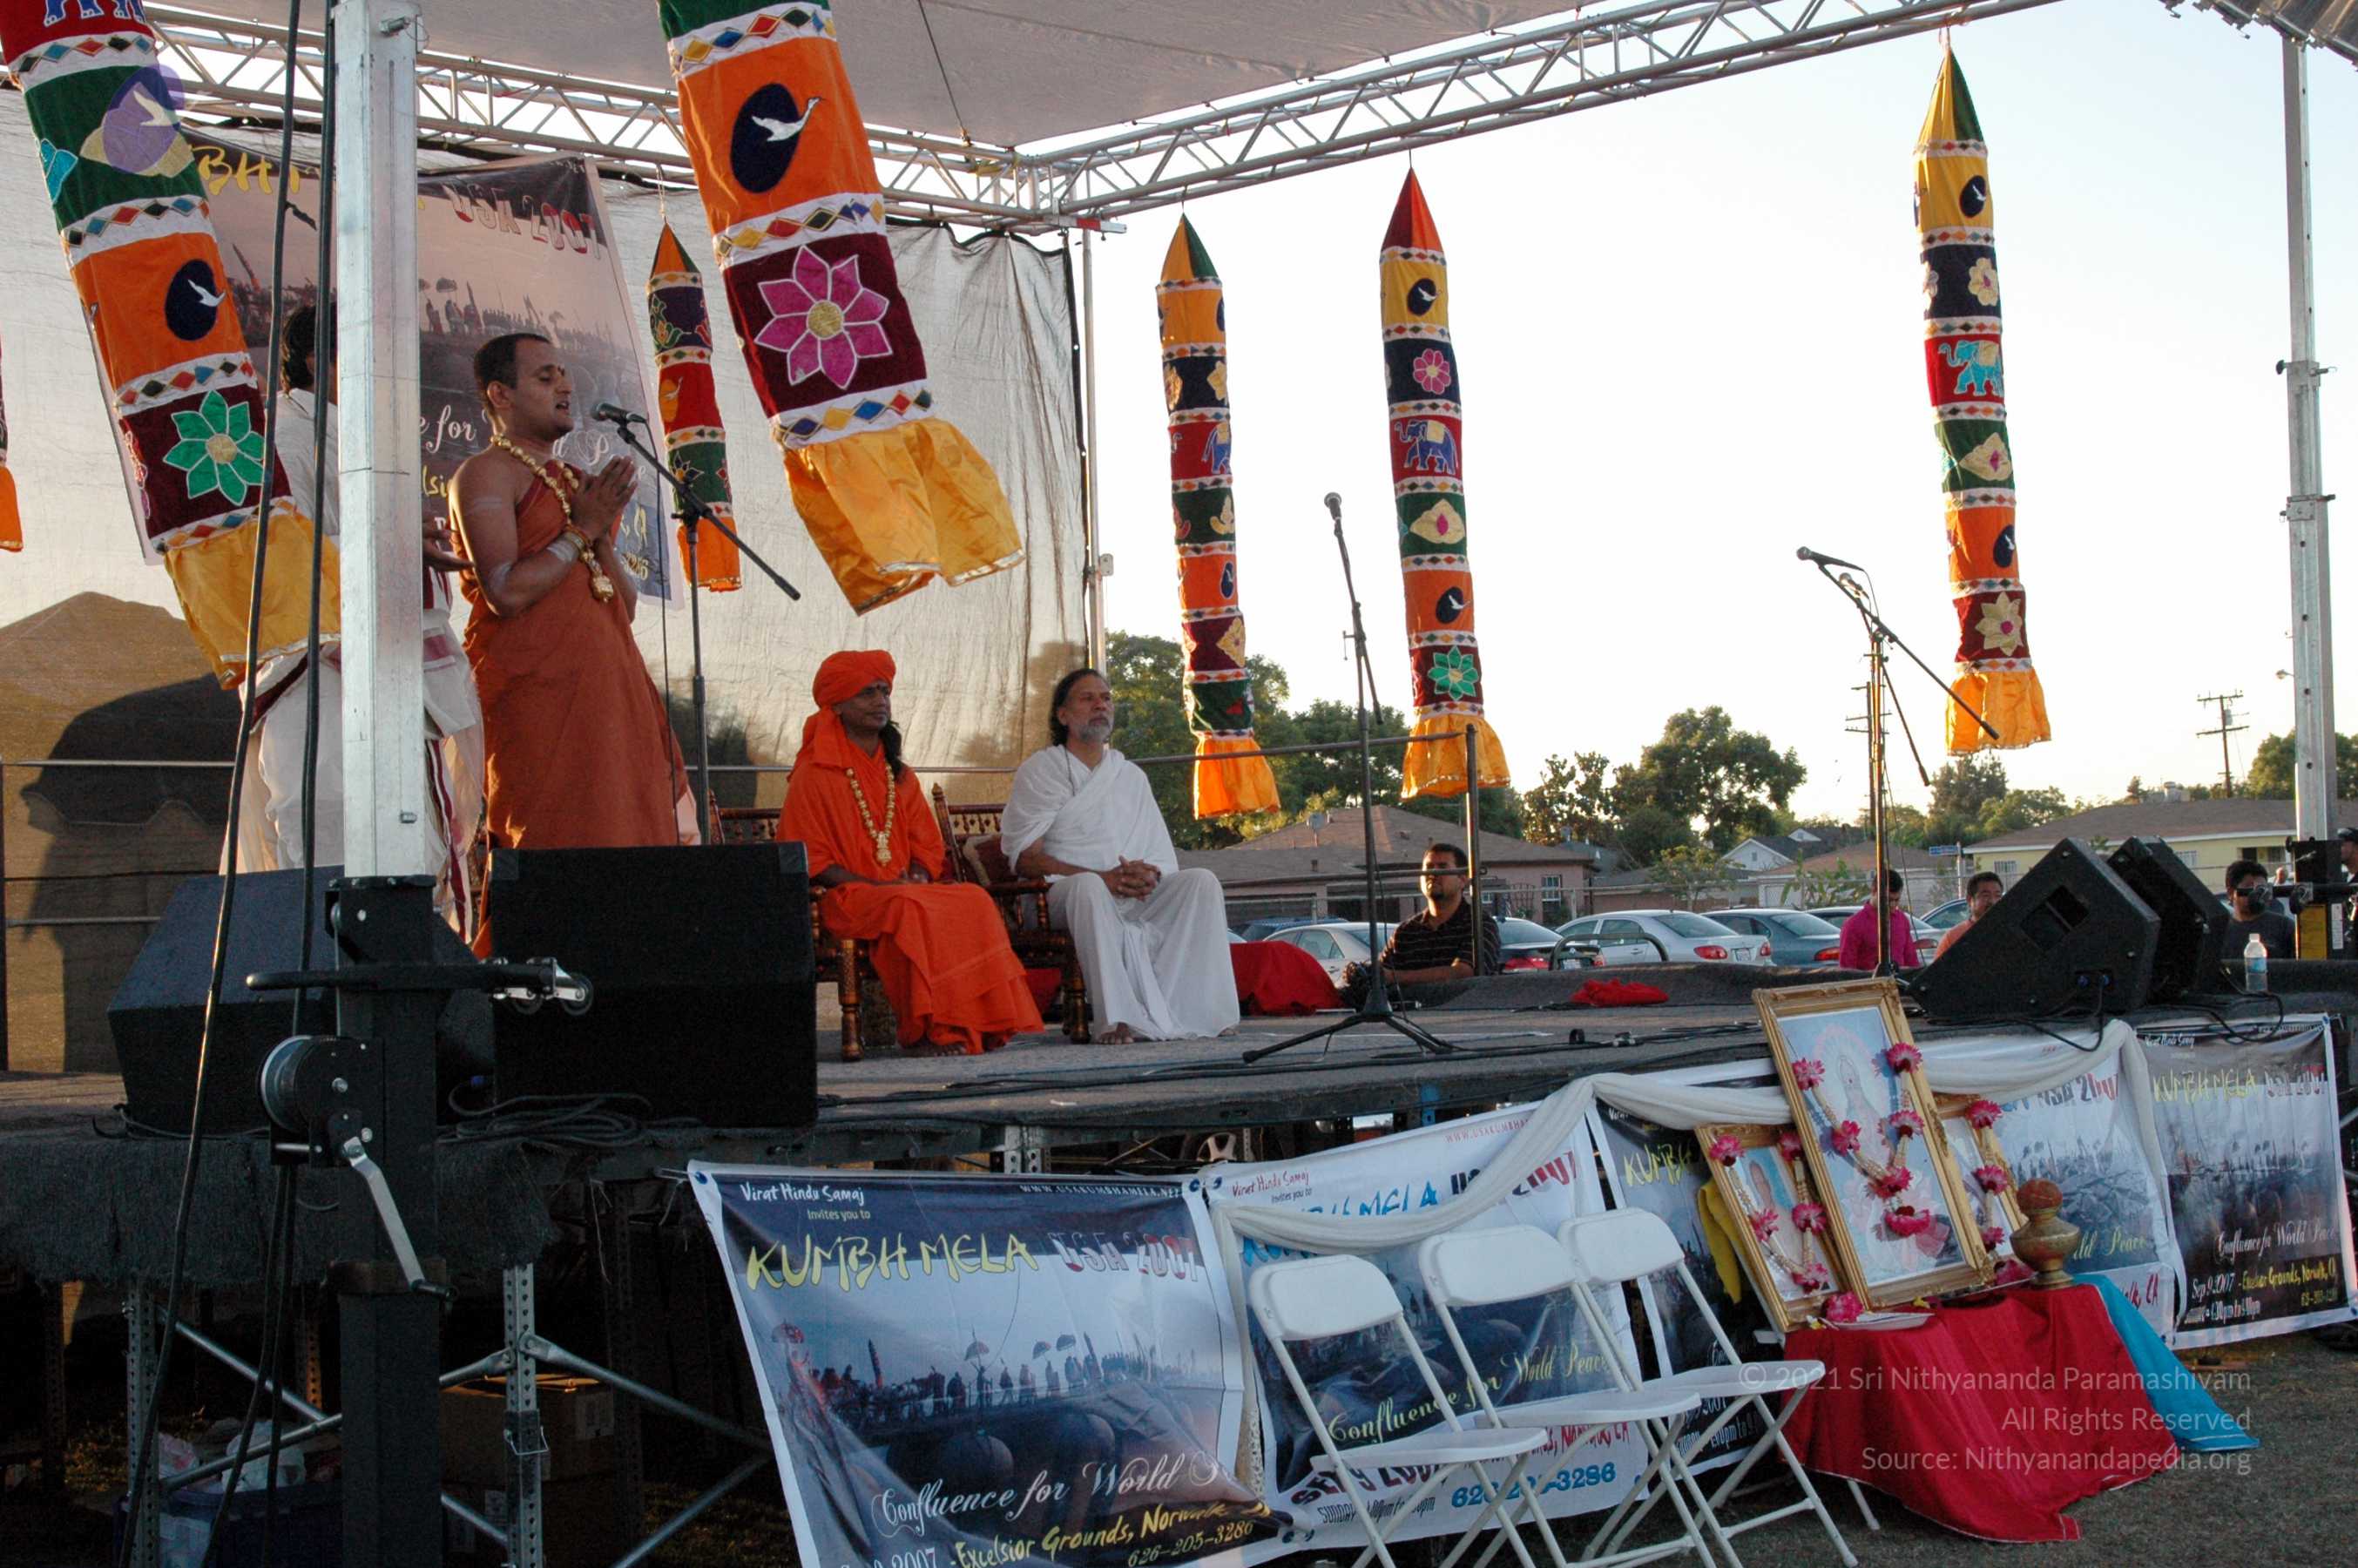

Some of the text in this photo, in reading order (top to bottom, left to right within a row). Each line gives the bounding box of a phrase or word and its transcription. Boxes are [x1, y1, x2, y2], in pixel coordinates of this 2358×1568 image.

[426, 404, 476, 454] for
[2213, 1068, 2256, 1100] MELA
[740, 1181, 865, 1206] Virat Hindu Samaj
[807, 1208, 871, 1221] Invites you to
[747, 1232, 910, 1292] KUMBH
[919, 1232, 1038, 1283] MELA
[1500, 1345, 1557, 1384] World
[871, 1478, 1017, 1538] Confluence
[1004, 1470, 1071, 1522] for
[1081, 1452, 1186, 1497] World
[1041, 1515, 1134, 1562] Grounds,
